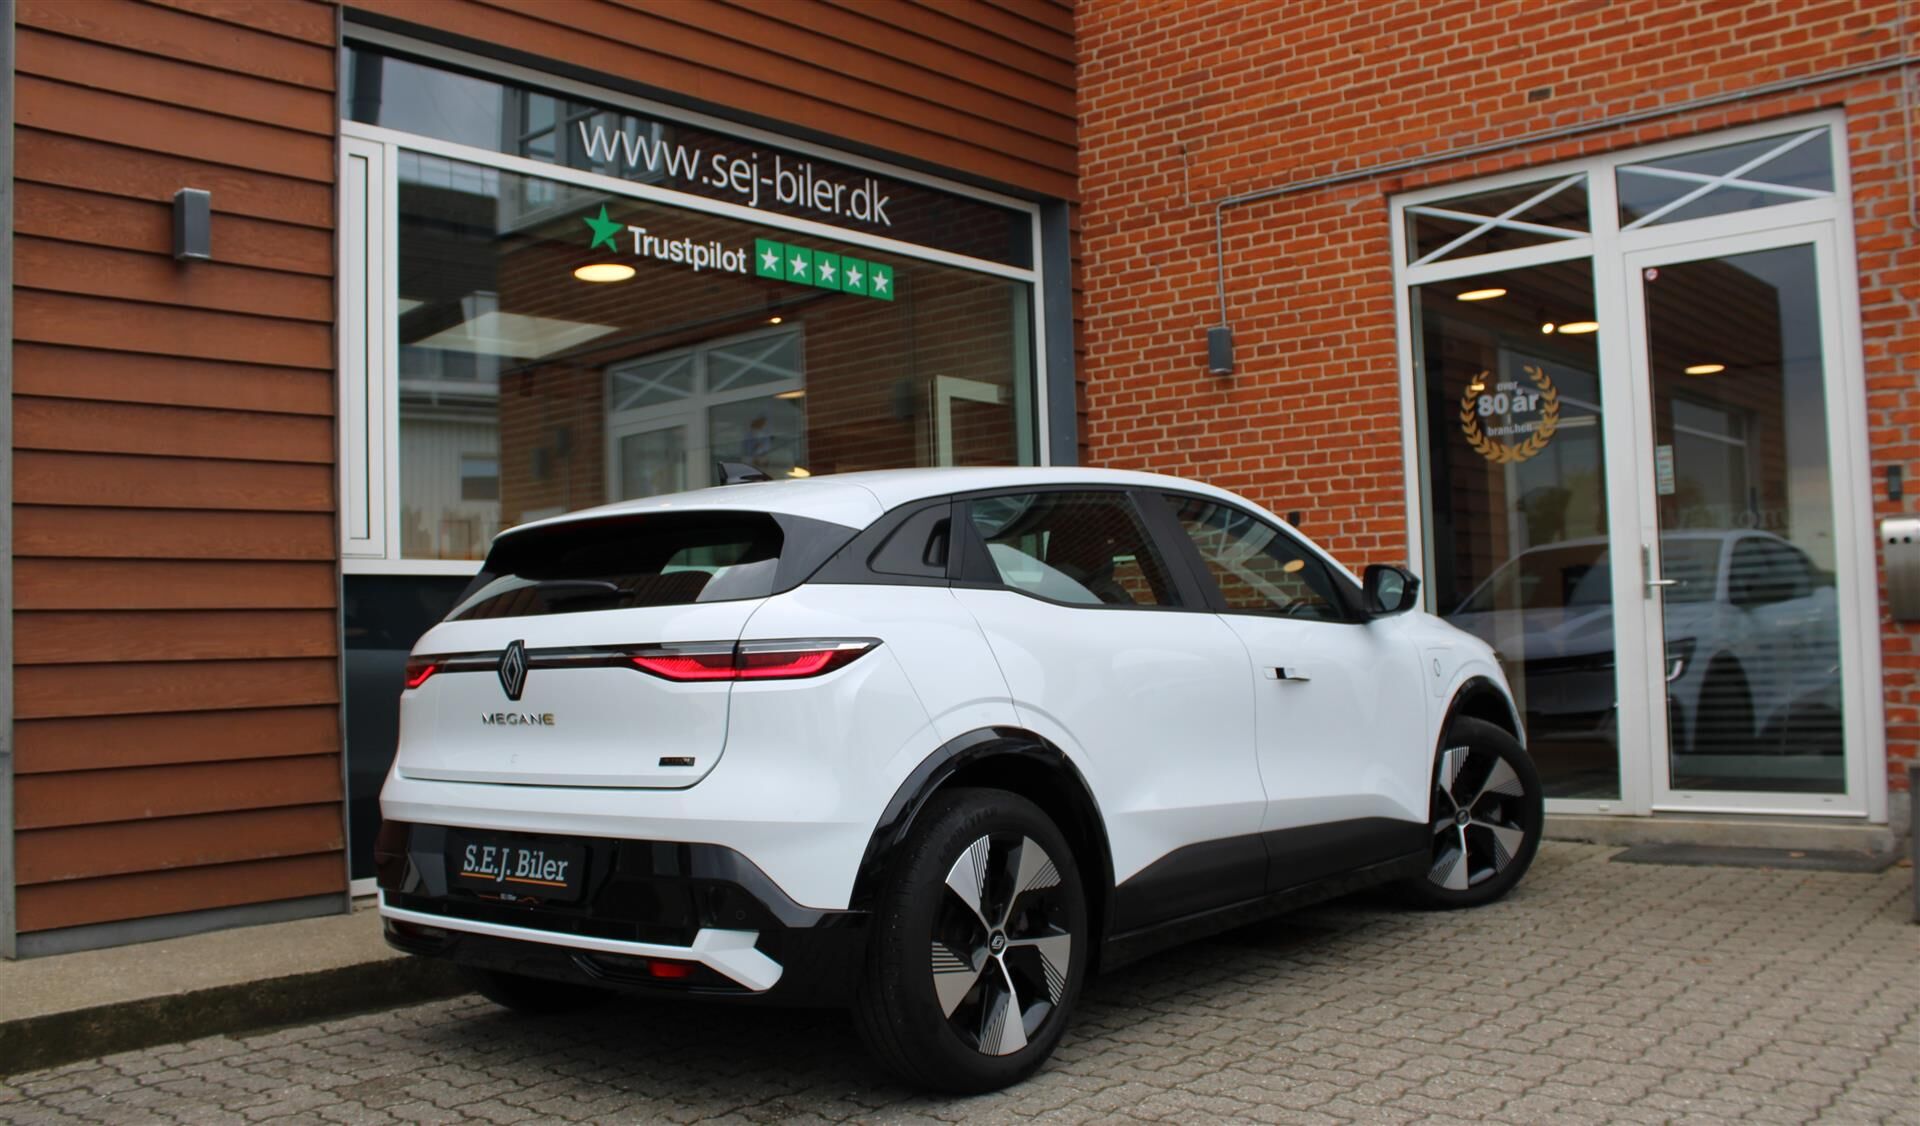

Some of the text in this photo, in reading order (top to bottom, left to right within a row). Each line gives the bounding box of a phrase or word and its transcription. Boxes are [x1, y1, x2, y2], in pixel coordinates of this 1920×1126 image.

[578, 120, 892, 227] www.sej-biler.dk
[627, 225, 748, 274] Trustpilot
[1478, 388, 1540, 416] 80 år
[481, 711, 555, 726] MEGANE
[463, 844, 569, 882] S.E.J. Biler
